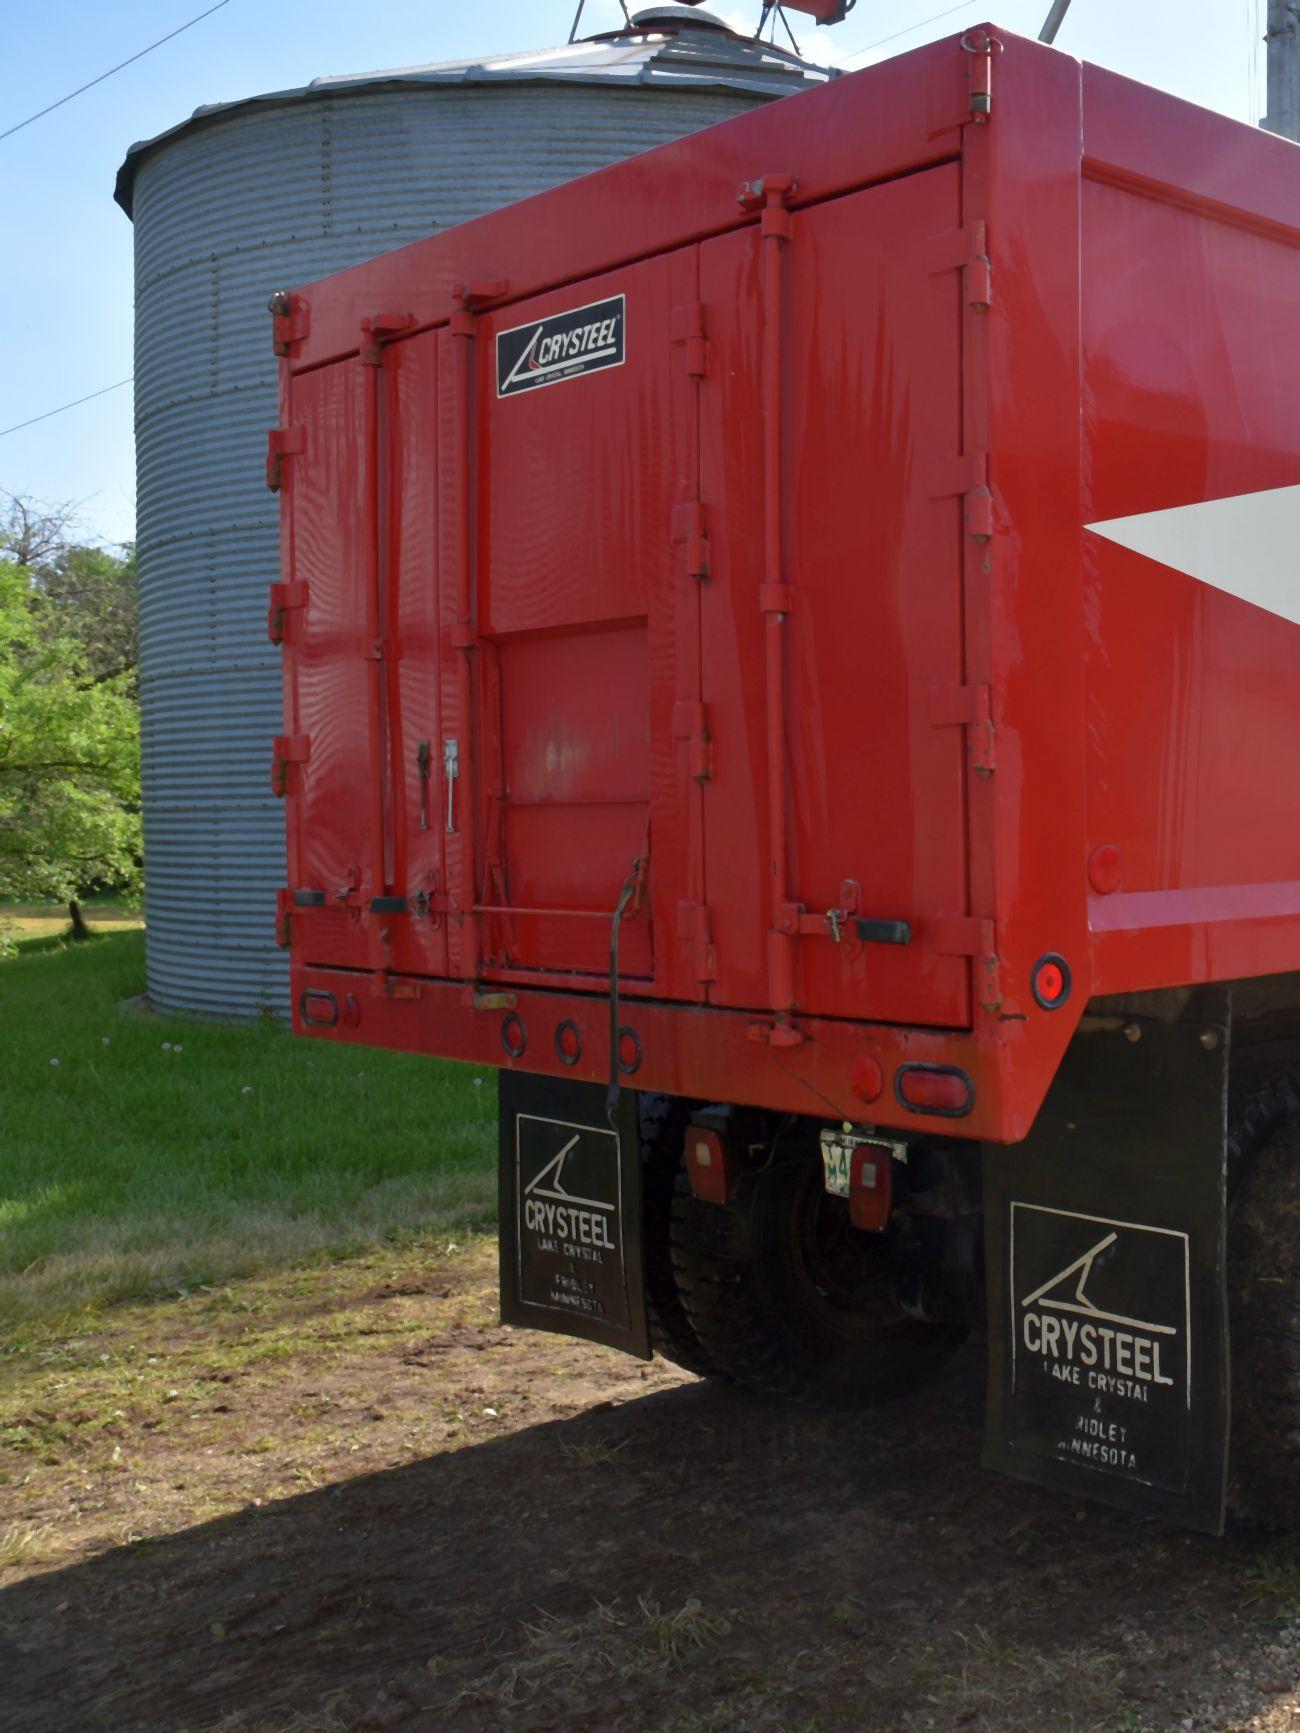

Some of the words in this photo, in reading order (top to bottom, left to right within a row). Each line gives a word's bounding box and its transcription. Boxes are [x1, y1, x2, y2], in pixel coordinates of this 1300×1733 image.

[538, 317, 616, 364] CRYSTEEL
[524, 1199, 615, 1249] CRYSTEEL
[1023, 1312, 1174, 1385] CRYSTEEL
[1088, 1371, 1148, 1402] CRYSTAL
